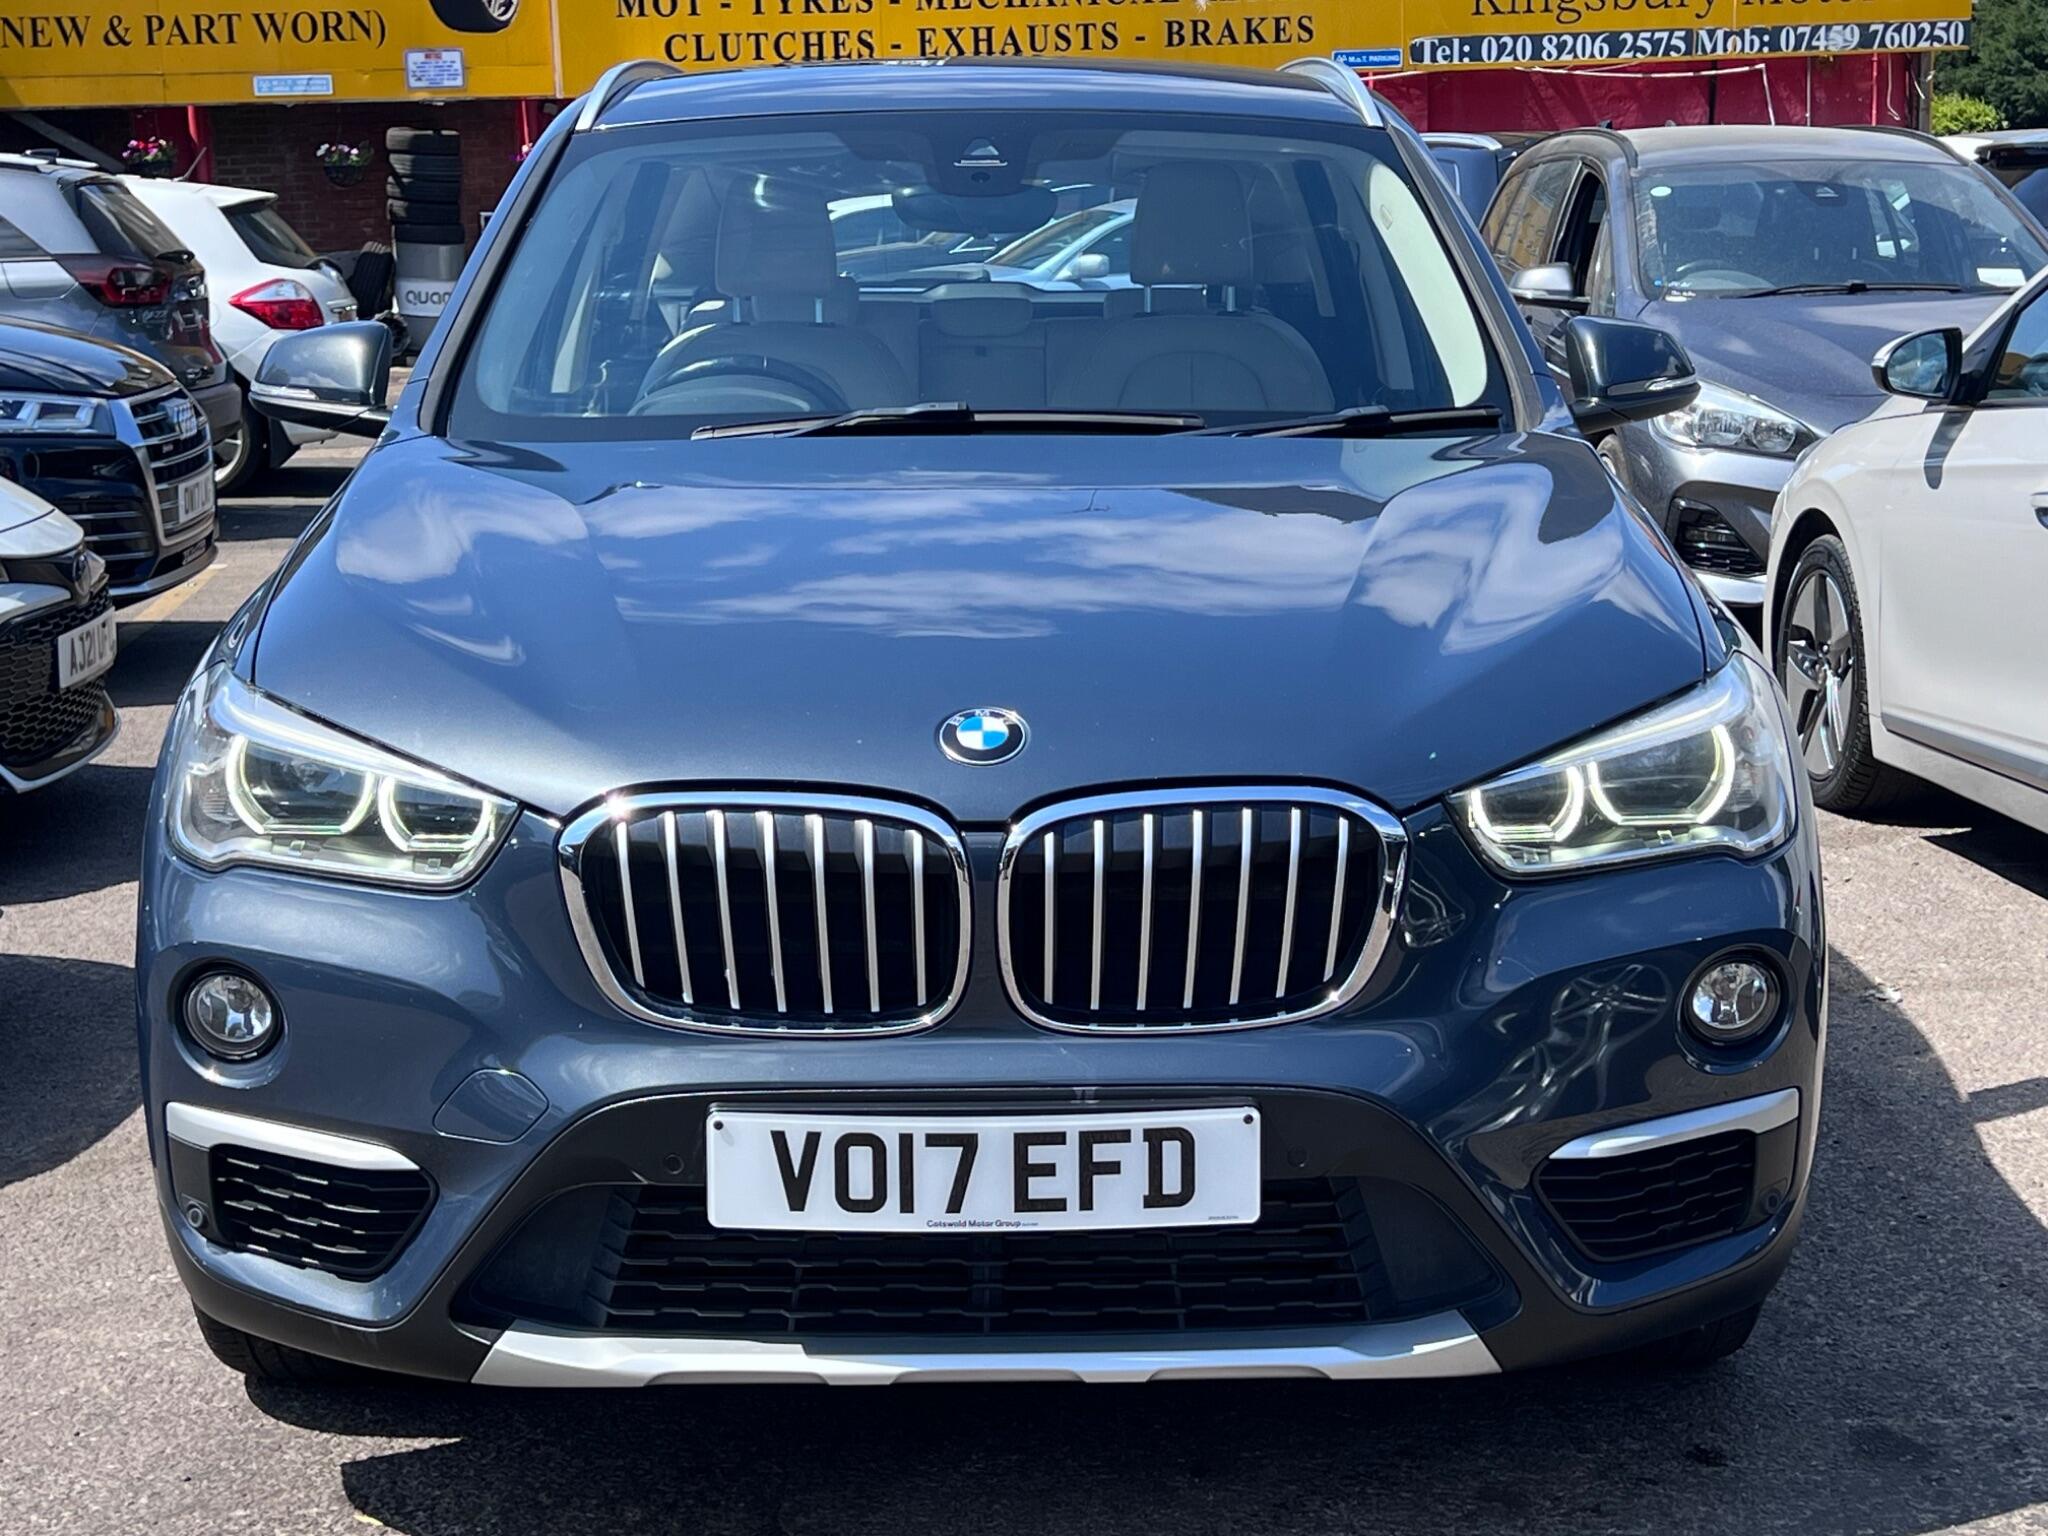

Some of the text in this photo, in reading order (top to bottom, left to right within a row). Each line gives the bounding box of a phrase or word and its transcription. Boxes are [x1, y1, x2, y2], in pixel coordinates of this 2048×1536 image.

[0, 10, 386, 49] NEW & PART WORN)
[664, 30, 875, 62] CLUTCHES
[917, 22, 1119, 57] EXHAUSTS
[1164, 16, 1314, 47] BRAKES
[1415, 38, 1471, 64] Tel:
[1481, 36, 1532, 63] 020
[1541, 33, 1608, 61] 8206
[1618, 30, 1687, 59] 2575
[1696, 28, 1770, 55] Mob:
[1869, 20, 1965, 49] 760250
[770, 1126, 1195, 1214] VO17 EFD
[968, 1219, 994, 1228] Motor
[995, 1219, 1021, 1229] Group
